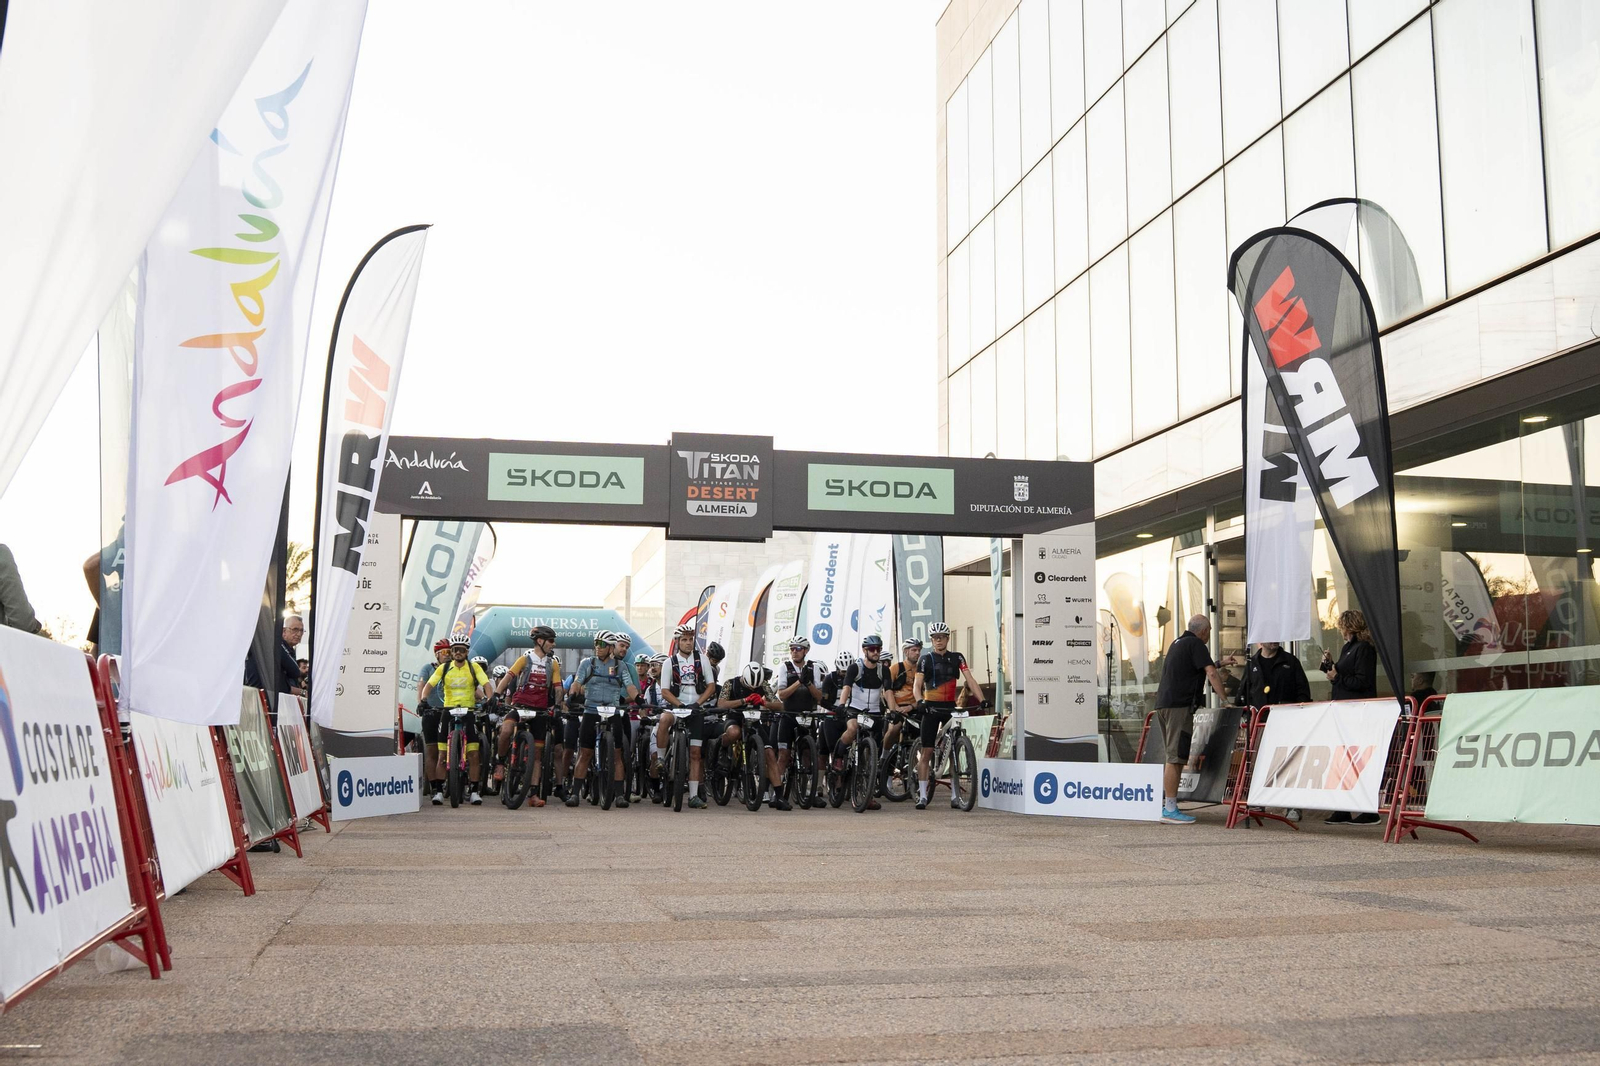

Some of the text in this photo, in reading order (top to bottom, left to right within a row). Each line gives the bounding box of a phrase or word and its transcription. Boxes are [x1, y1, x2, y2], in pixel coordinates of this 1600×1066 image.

[164, 57, 314, 513] Andalucía
[332, 334, 392, 575] MRW
[385, 448, 470, 472] Andalucía
[687, 486, 759, 500] DESERT
[696, 503, 748, 515] ALMERÍA
[970, 504, 1073, 515] DIPUTACIÓN DE ALMERÍA
[1051, 547, 1082, 555] ALMERÍA
[405, 521, 465, 651] SKOD
[820, 543, 840, 619] Cleardent
[1047, 574, 1087, 582] Cleardent
[510, 616, 599, 630] UNIVERSAE
[576, 630, 587, 638] de
[1192, 713, 1214, 723] KODA
[23, 721, 99, 785] COSTA DE
[1263, 744, 1377, 790] MRW
[356, 775, 414, 798] Cleardent
[991, 776, 1023, 796] Cleardent
[1063, 781, 1154, 802] Cleardent
[32, 783, 121, 915] ALMERÍA
